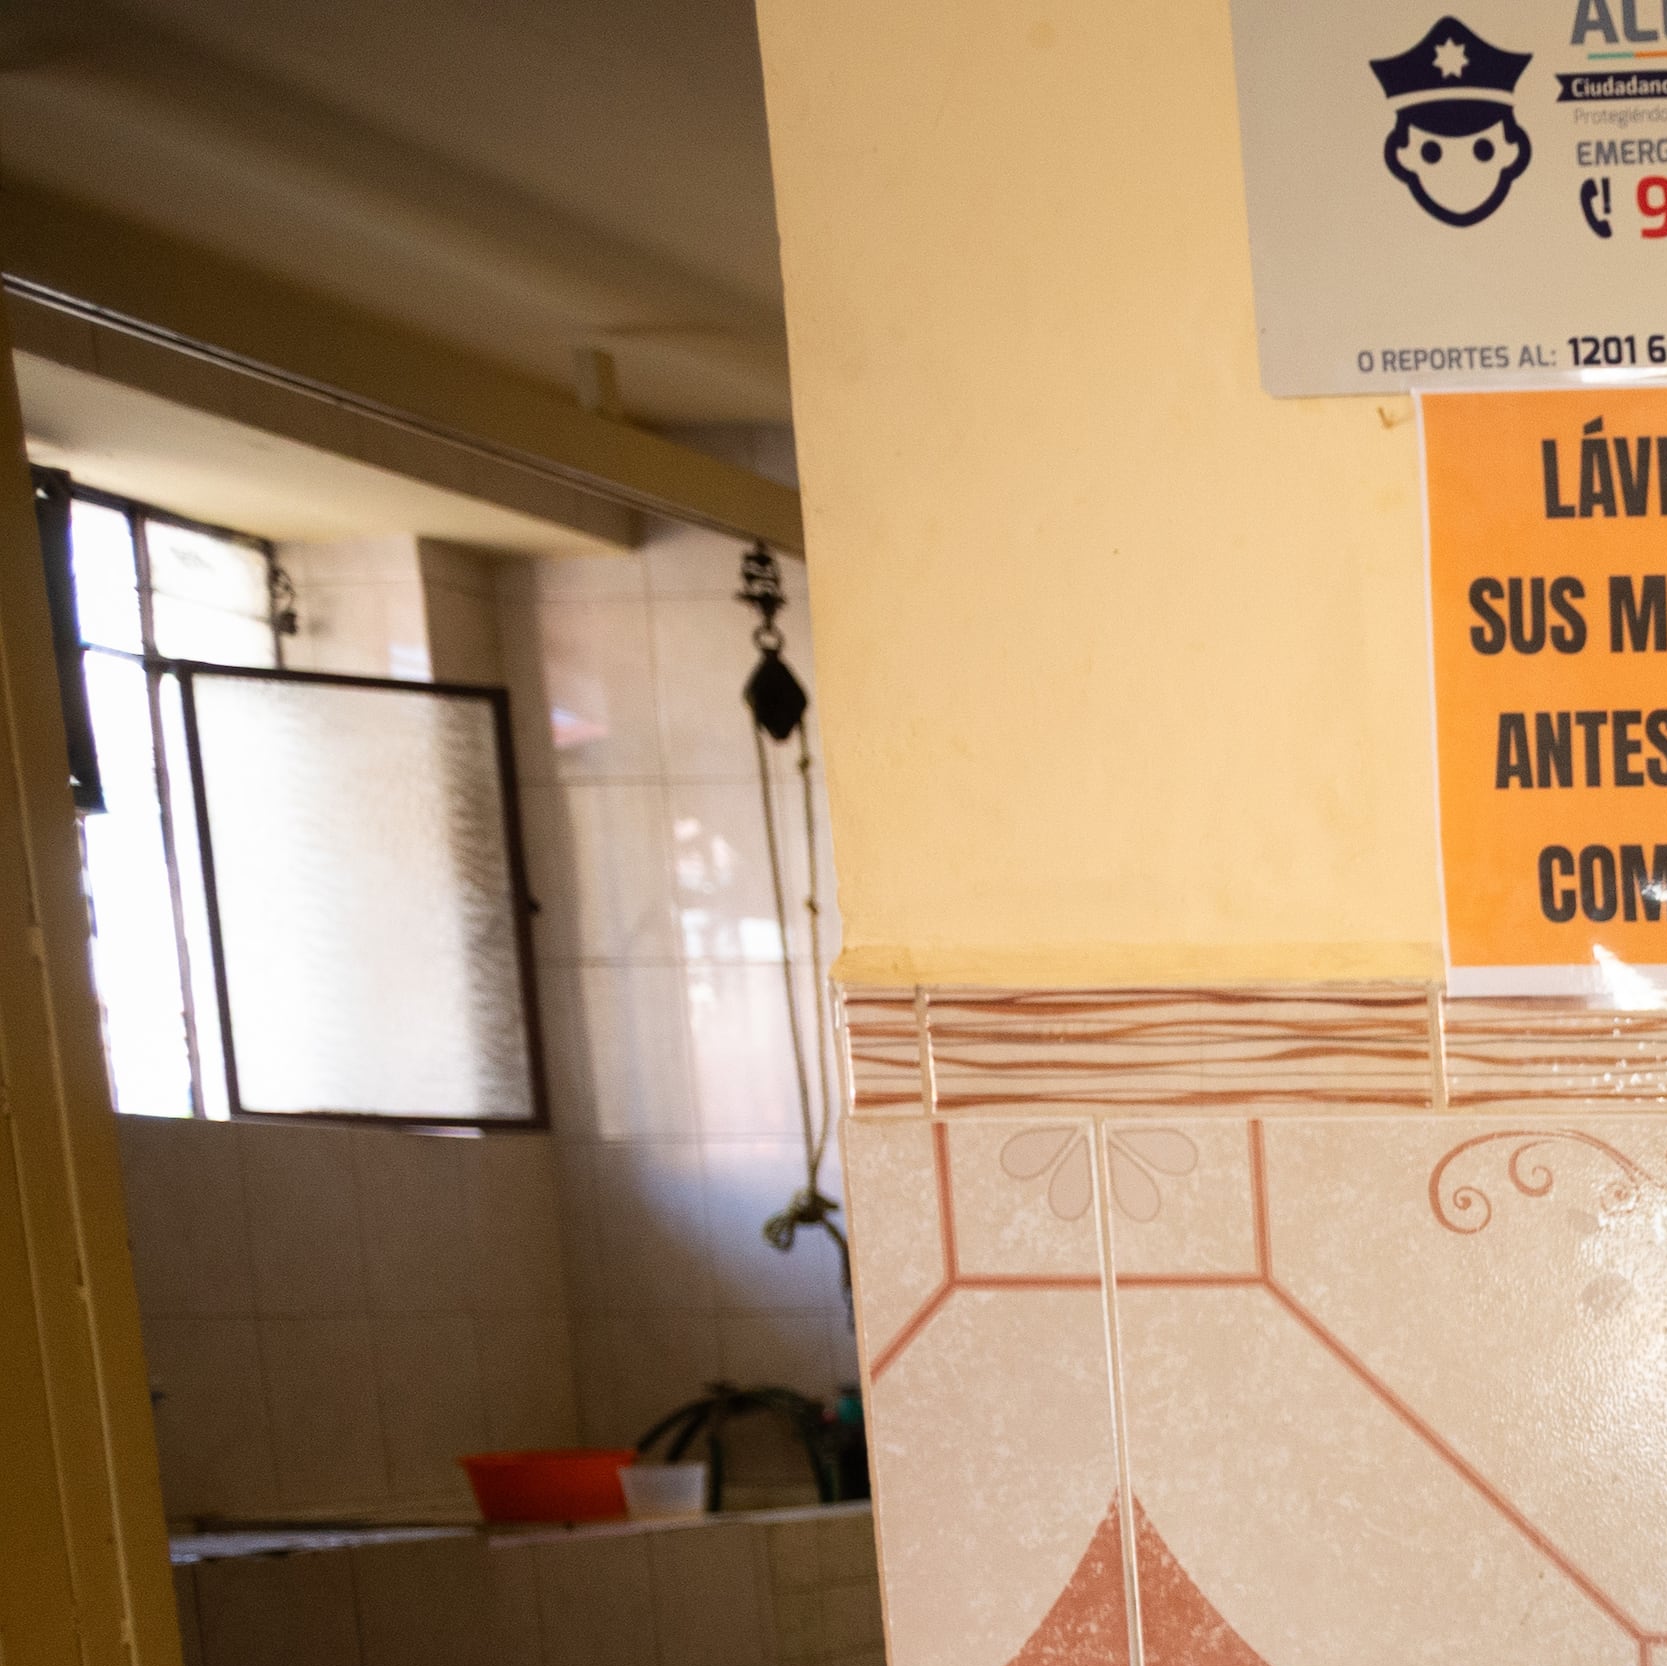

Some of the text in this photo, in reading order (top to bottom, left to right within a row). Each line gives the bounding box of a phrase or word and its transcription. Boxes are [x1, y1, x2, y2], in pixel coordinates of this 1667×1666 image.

[1358, 349, 1374, 372] O
[1383, 345, 1509, 371] REPORTES
[1519, 345, 1557, 367] AL:
[1568, 336, 1636, 366] 1201
[1468, 576, 1588, 655] SUS
